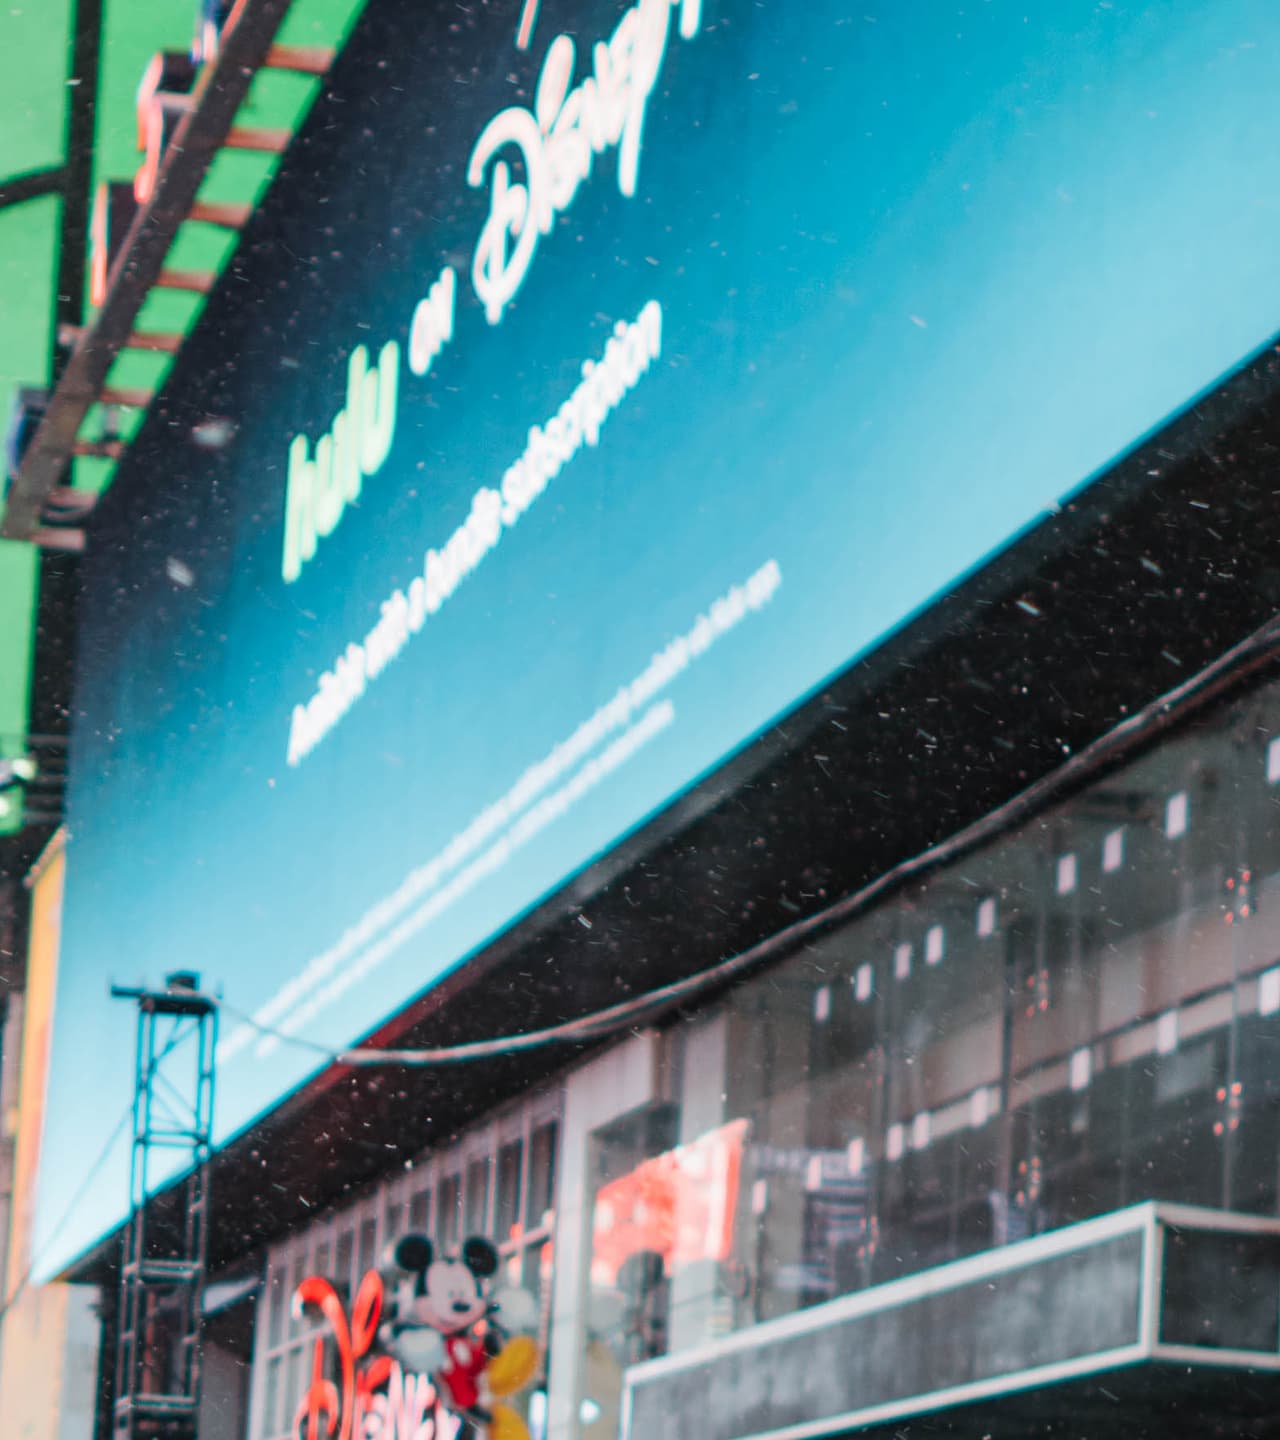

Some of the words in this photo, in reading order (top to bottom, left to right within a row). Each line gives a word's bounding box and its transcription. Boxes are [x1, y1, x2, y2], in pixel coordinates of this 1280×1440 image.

[282, 340, 399, 583] hulu
[410, 267, 455, 374] on
[501, 300, 662, 525] subscription
